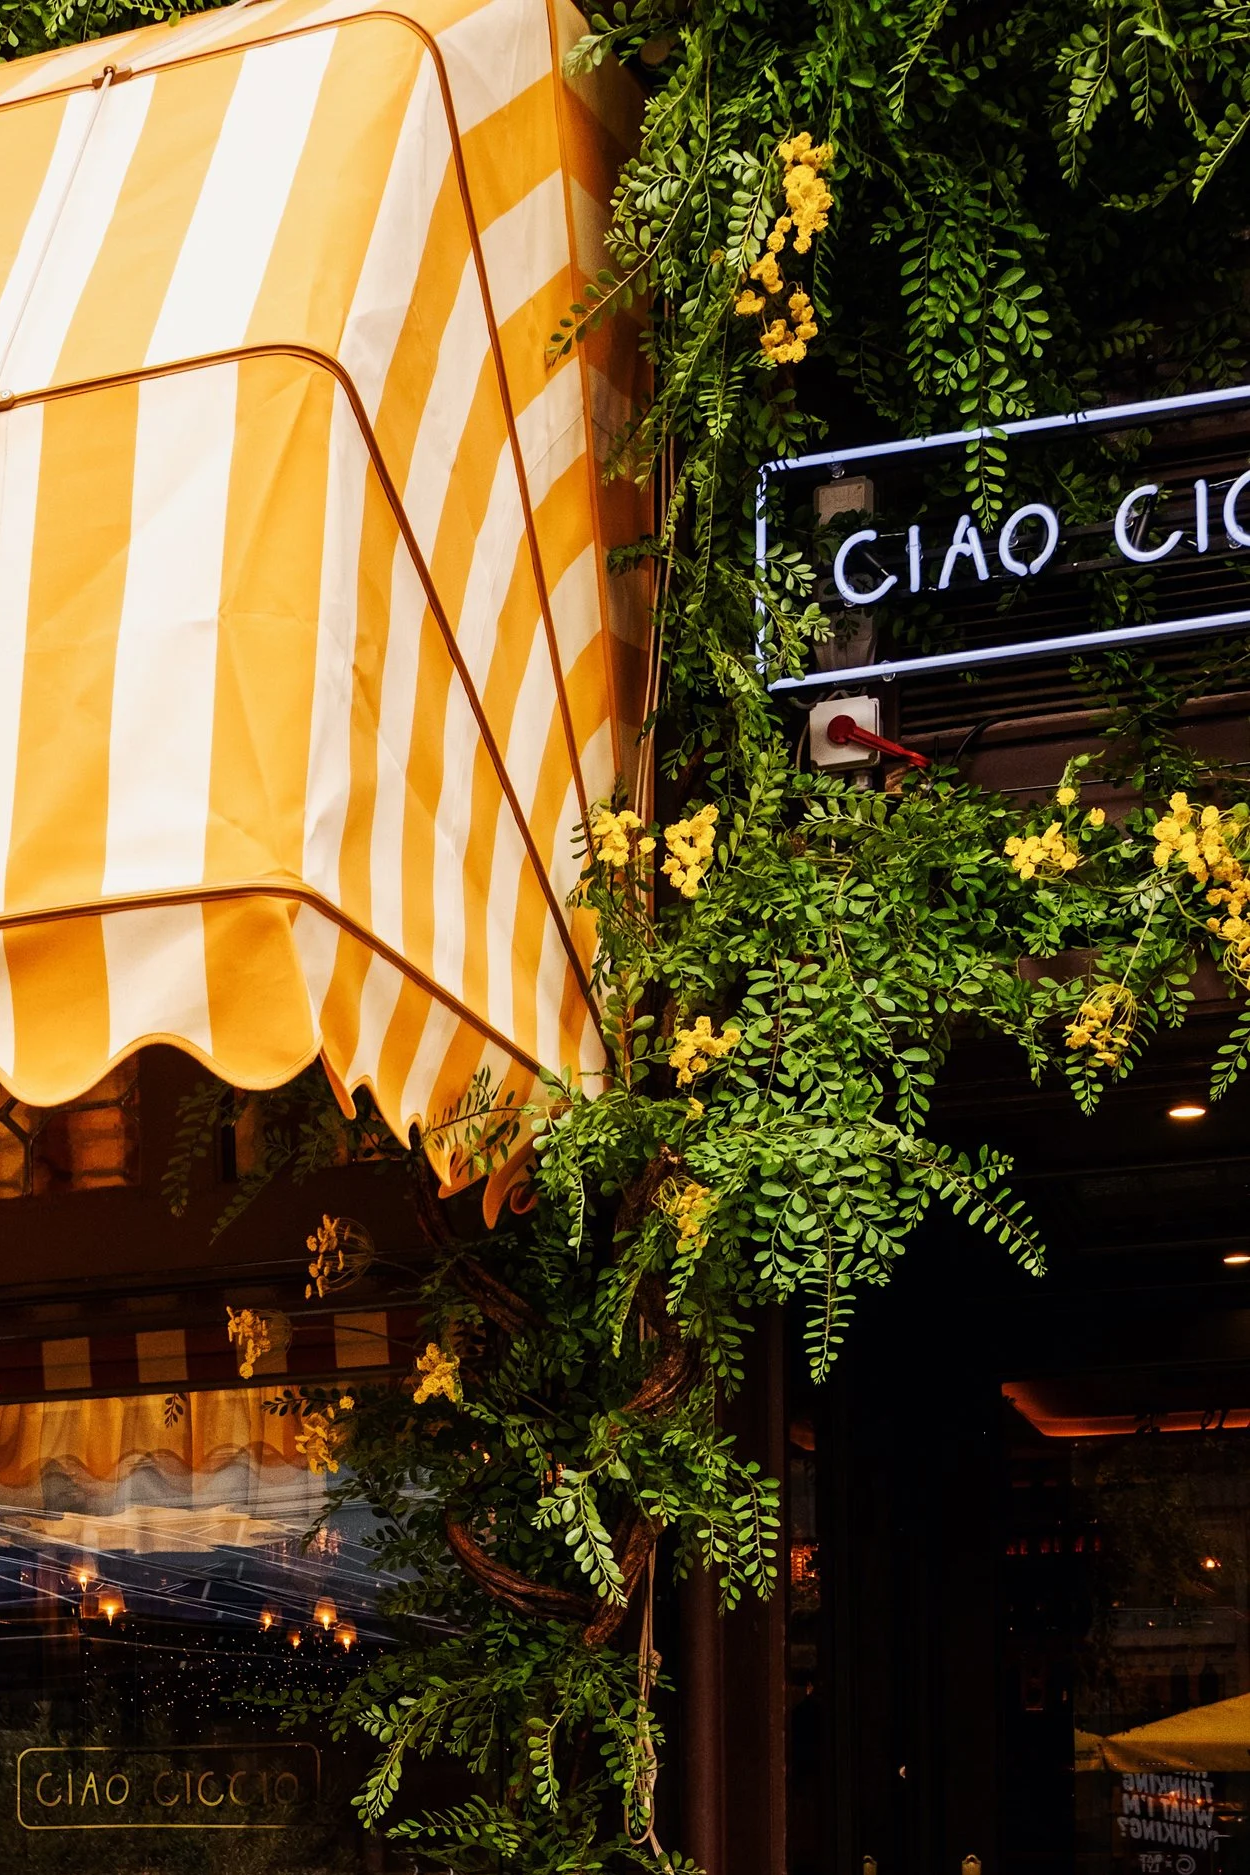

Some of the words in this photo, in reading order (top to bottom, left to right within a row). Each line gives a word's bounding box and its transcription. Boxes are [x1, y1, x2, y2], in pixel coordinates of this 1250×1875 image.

[834, 504, 1059, 604] CIAO
[36, 1770, 130, 1807] CIAO
[153, 1770, 299, 1807] CICCIO
